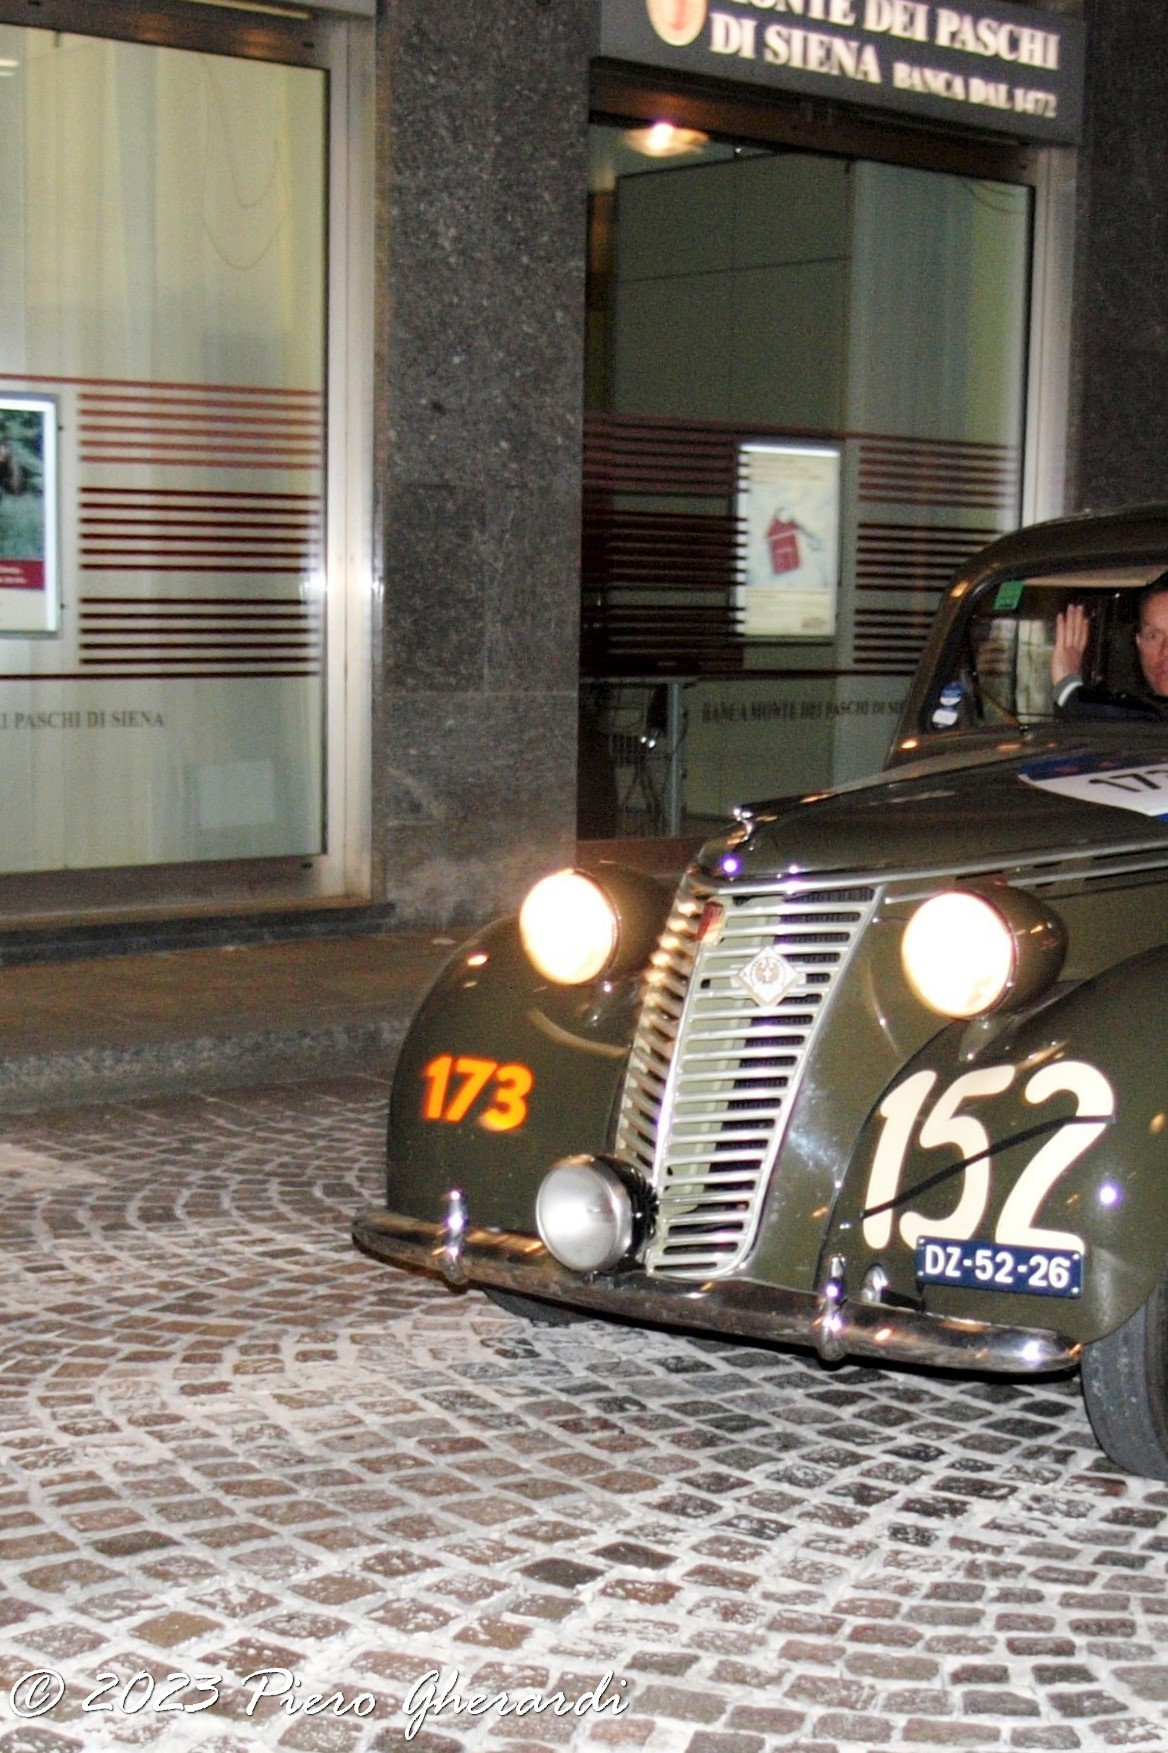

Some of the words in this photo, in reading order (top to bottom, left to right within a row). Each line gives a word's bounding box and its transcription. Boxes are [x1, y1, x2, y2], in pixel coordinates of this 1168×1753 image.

[709, 12, 757, 59] DI
[764, 24, 882, 84] SIENA
[863, 0, 929, 42] DEI
[935, 8, 1060, 71] PASCHI
[14, 711, 81, 729] PASCHI
[87, 711, 105, 728] DI
[111, 710, 165, 728] SIENA
[423, 1053, 535, 1134] 173
[862, 1060, 1115, 1255] 152
[923, 1243, 1073, 1290] DZ-52-26
